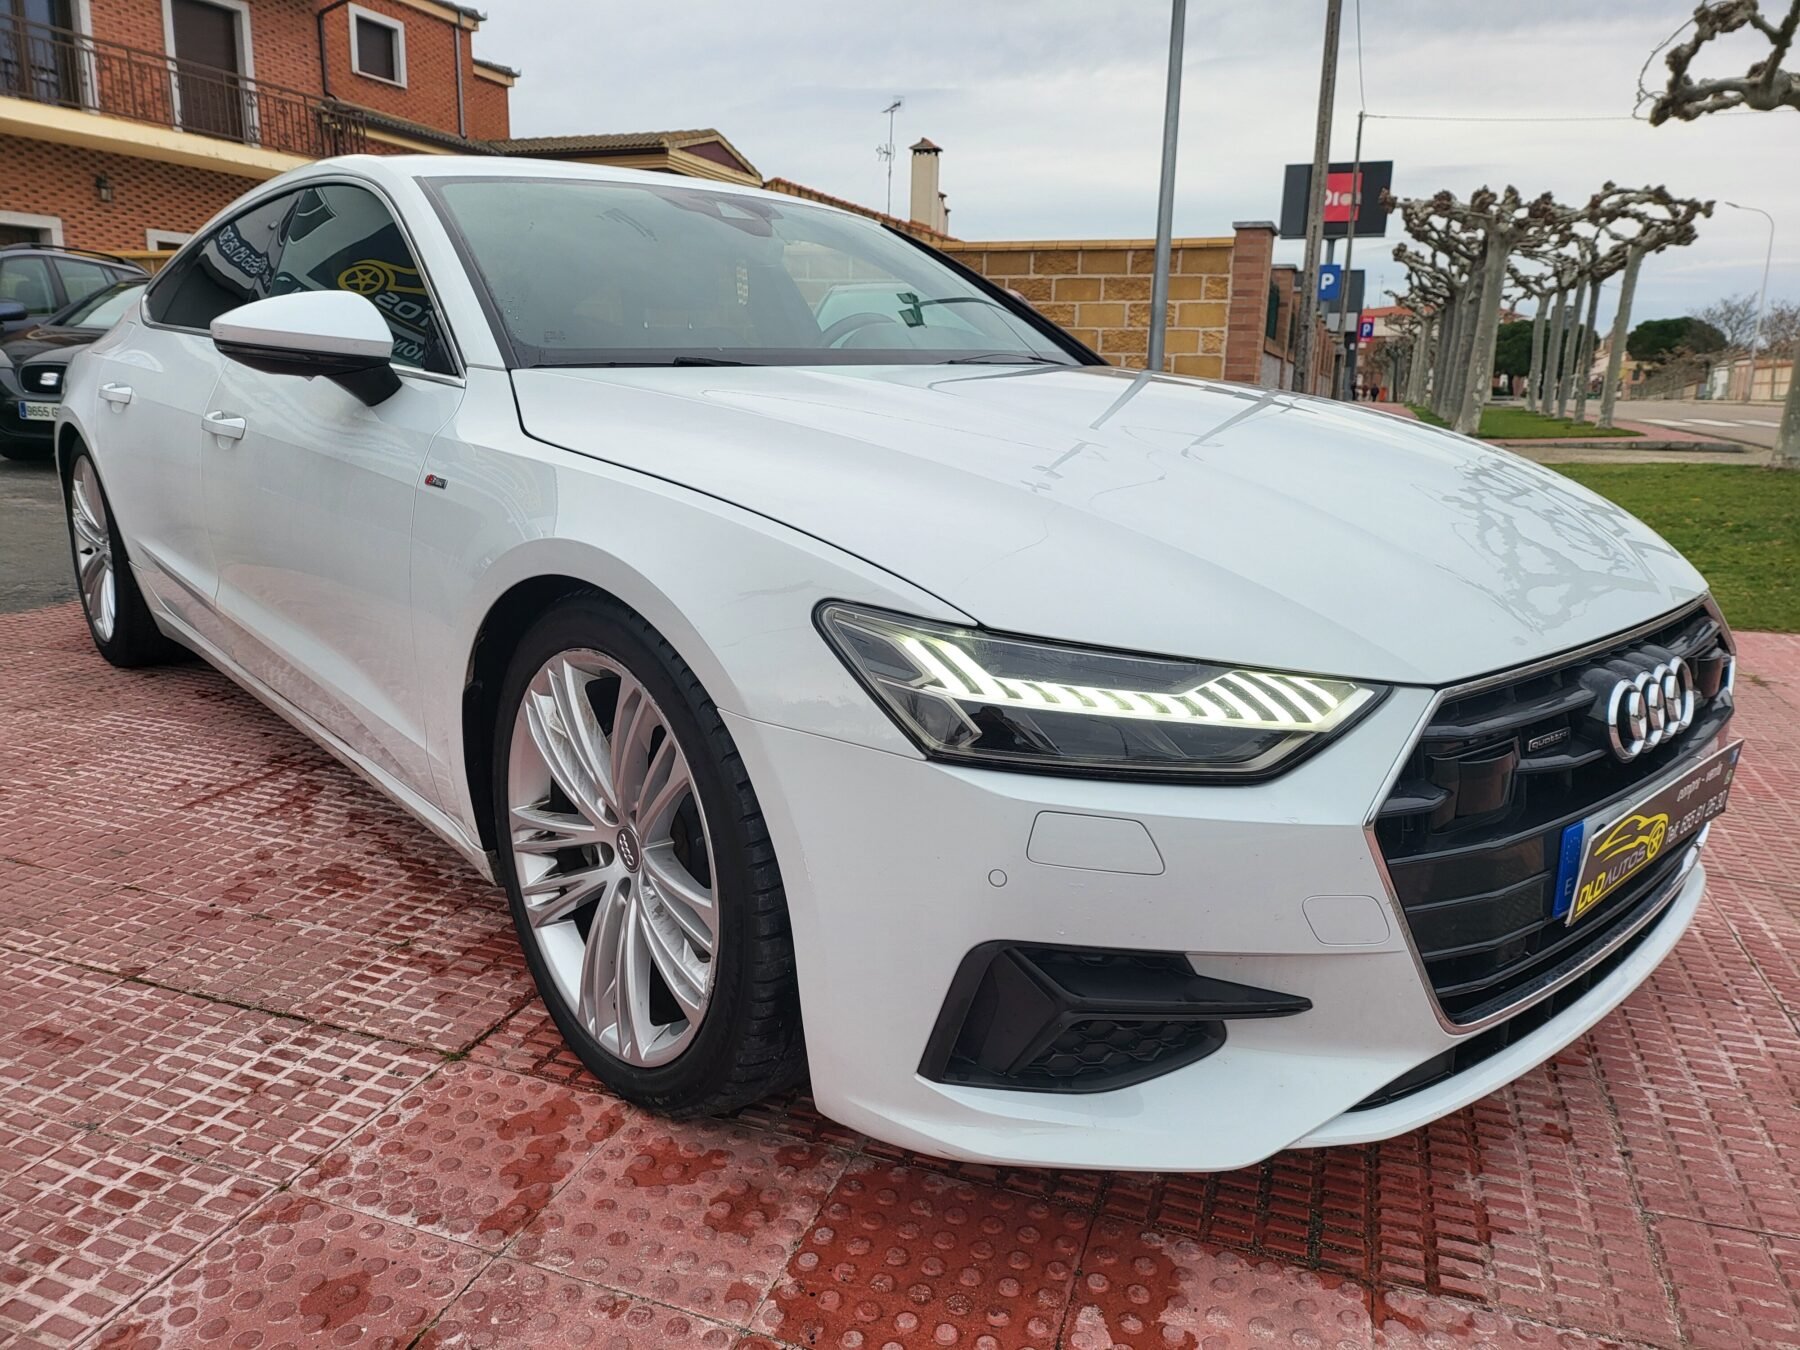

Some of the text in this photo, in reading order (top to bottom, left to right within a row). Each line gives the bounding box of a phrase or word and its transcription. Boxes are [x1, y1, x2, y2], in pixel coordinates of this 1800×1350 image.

[1321, 273, 1335, 290] P
[1362, 323, 1371, 336] P
[1564, 877, 1574, 896] E
